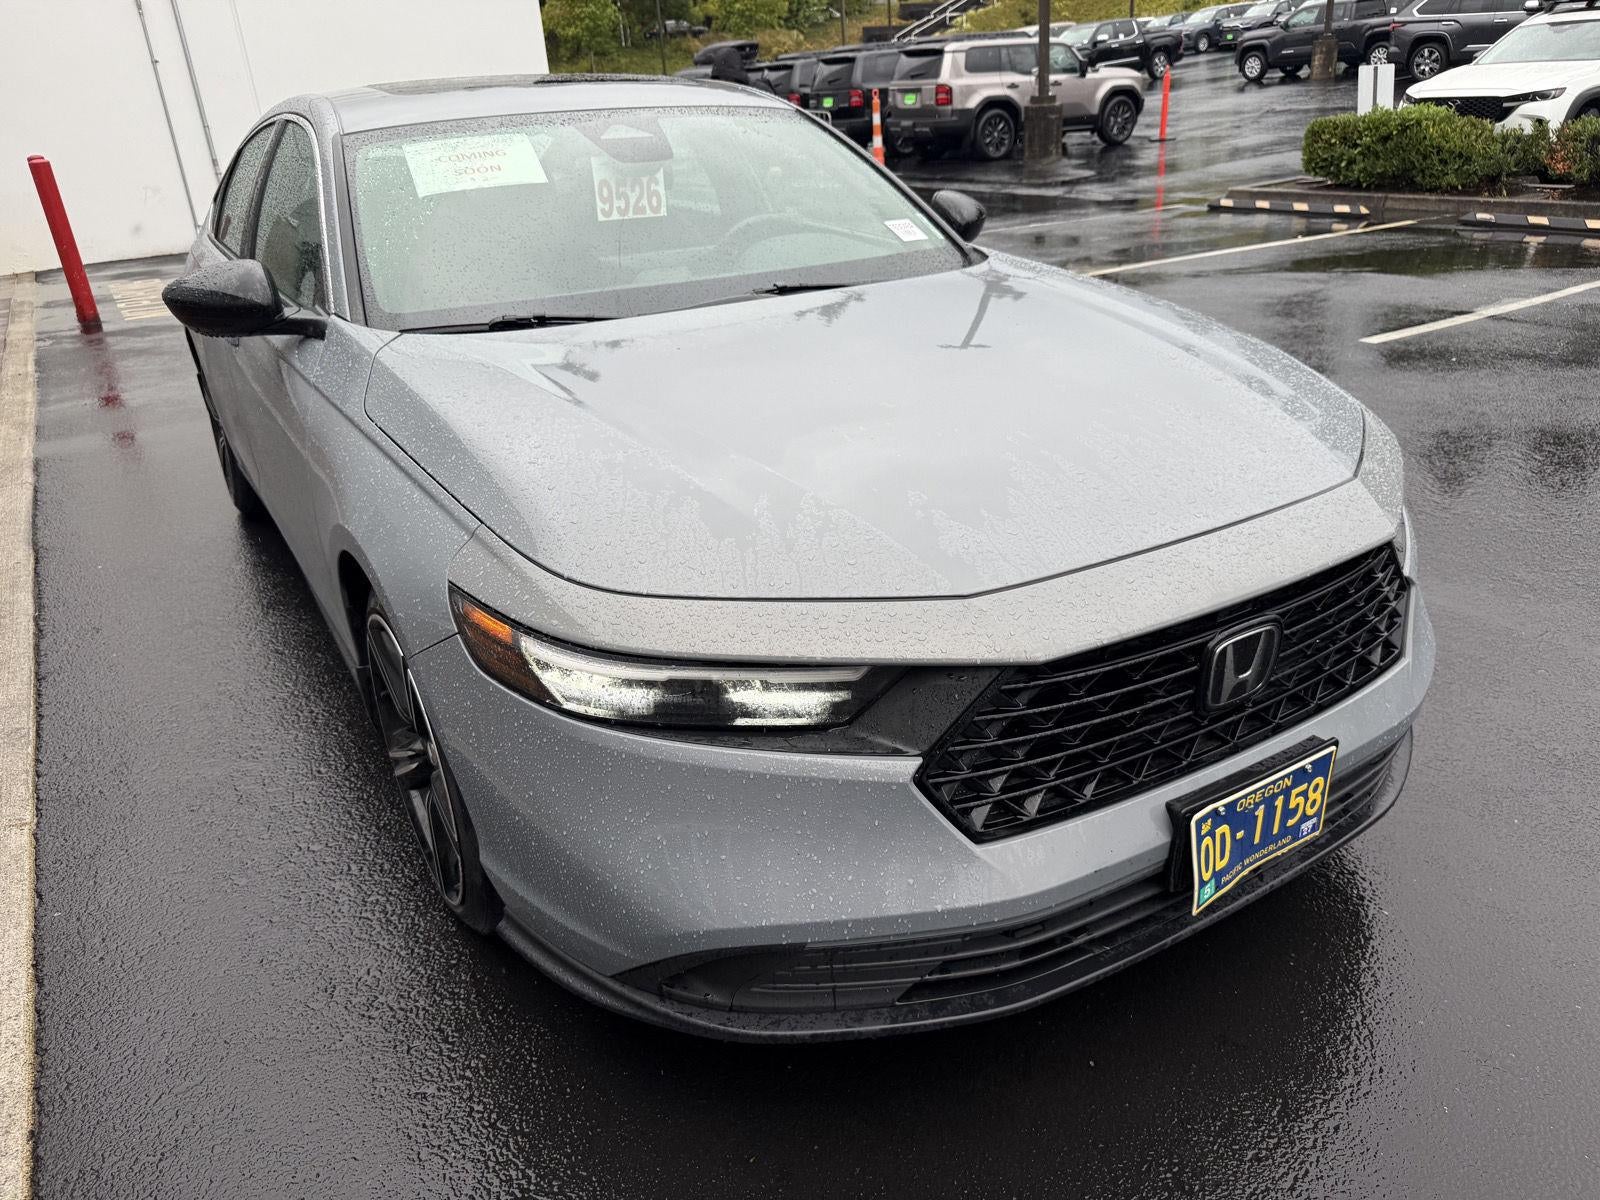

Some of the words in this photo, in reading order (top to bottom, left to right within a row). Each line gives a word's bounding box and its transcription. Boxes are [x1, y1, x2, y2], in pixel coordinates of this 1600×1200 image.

[438, 149, 507, 163] COMING
[453, 163, 503, 176] SOON
[598, 176, 662, 219] 9526
[1236, 774, 1293, 812] OREGON
[1243, 835, 1292, 866] WONDERLAND
[1221, 862, 1243, 885] PACIFIC
